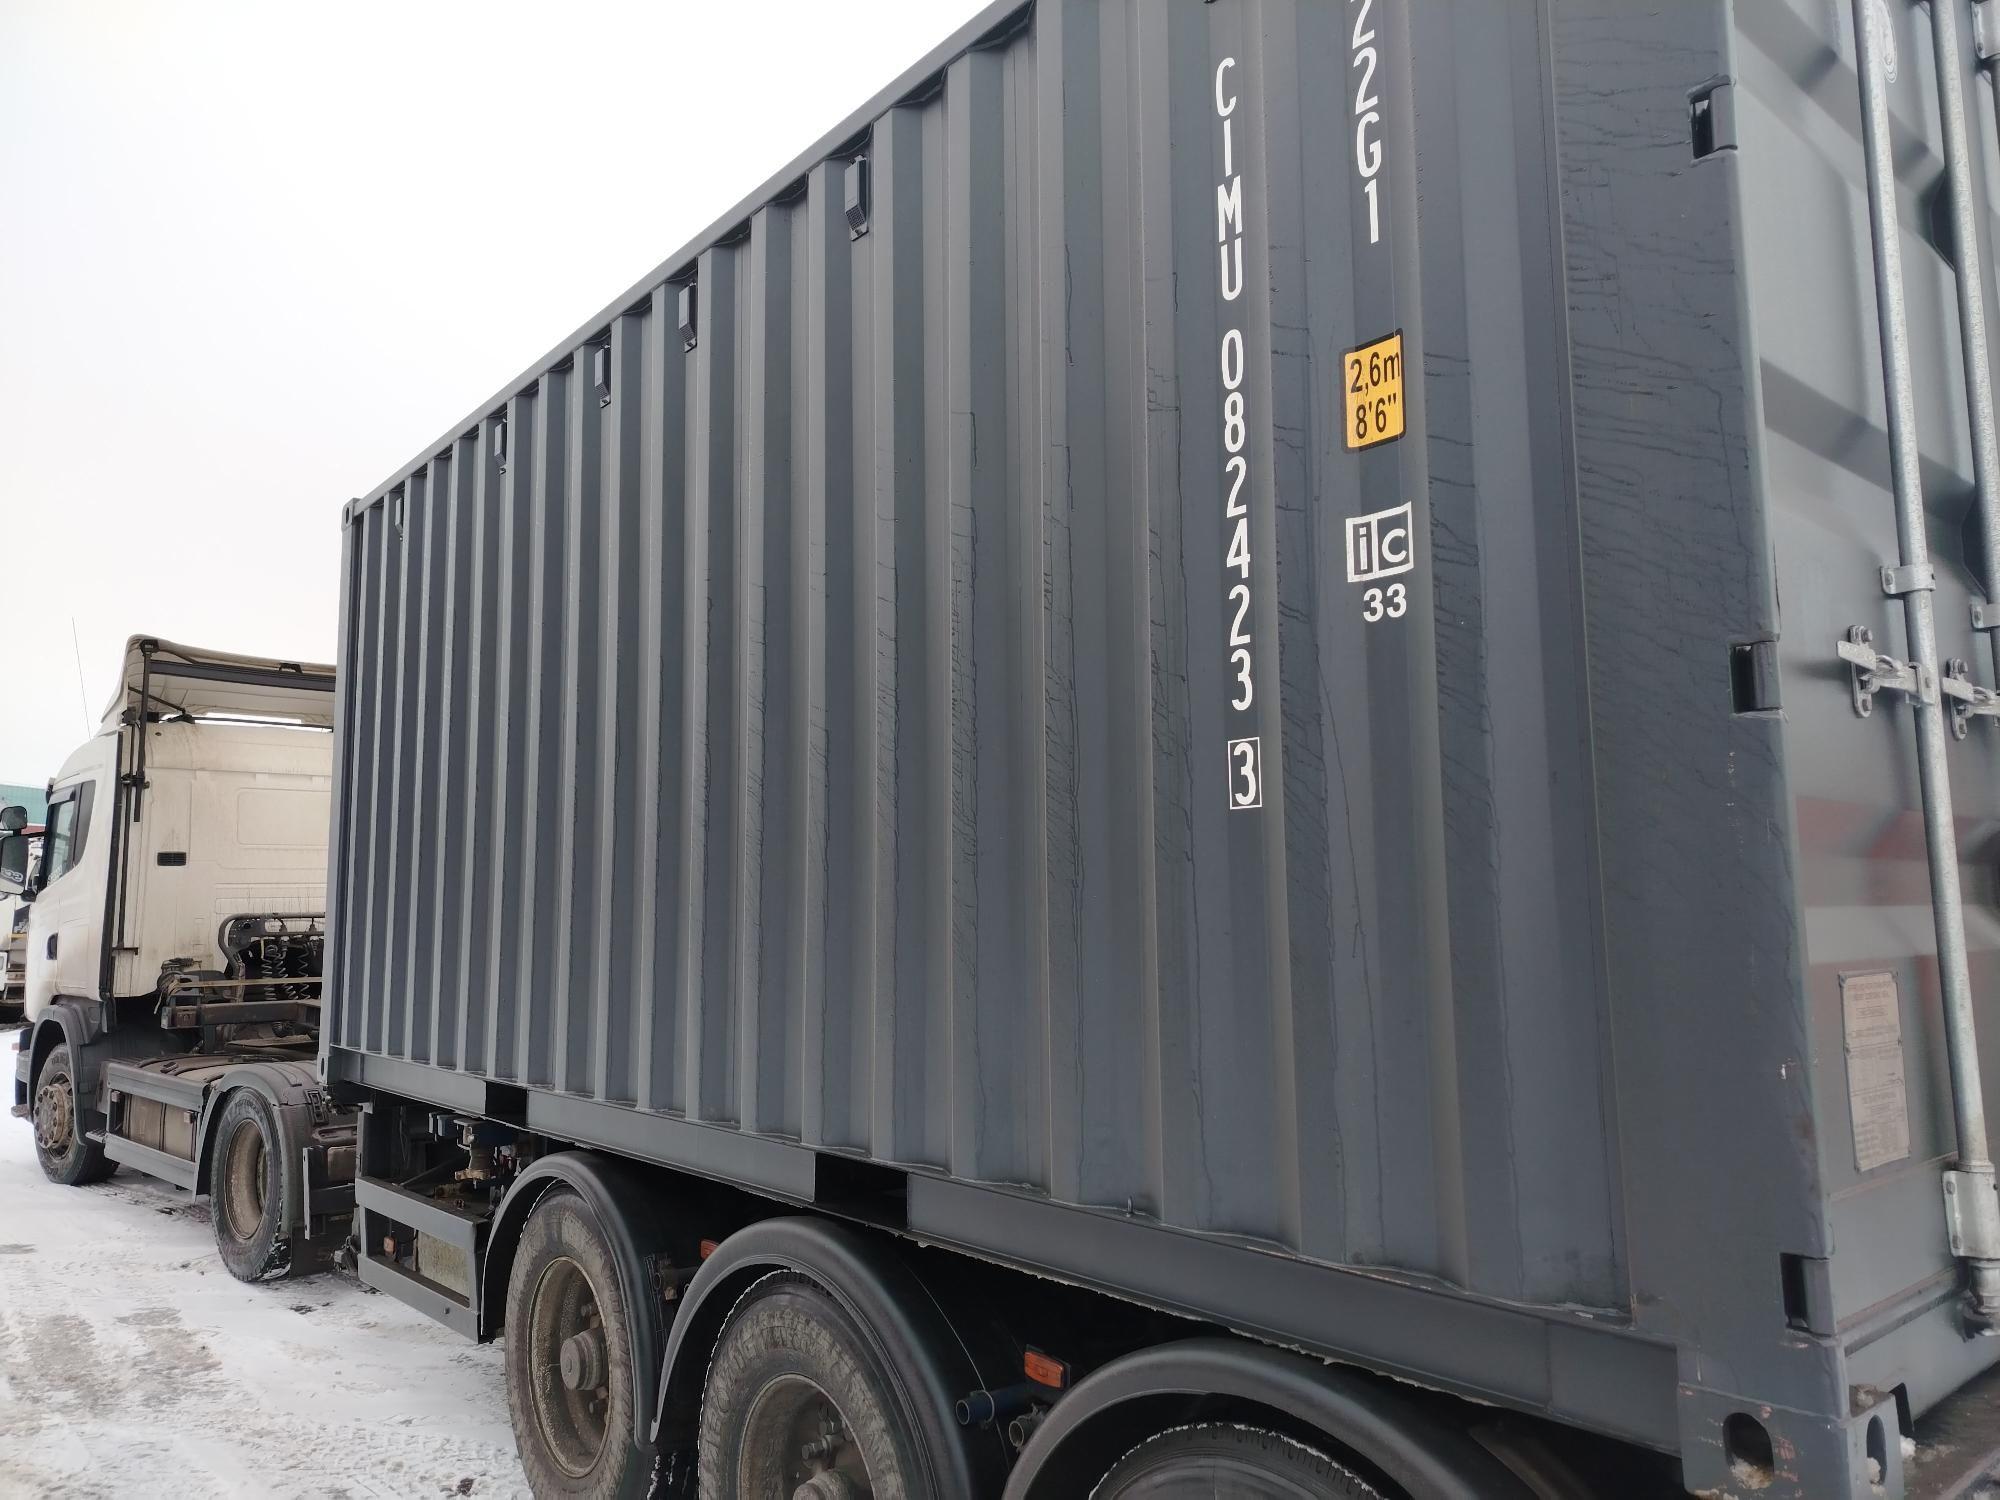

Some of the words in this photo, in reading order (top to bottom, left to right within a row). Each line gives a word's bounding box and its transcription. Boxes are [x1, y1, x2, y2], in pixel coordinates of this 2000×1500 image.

[1215, 57, 1243, 301] CIMU
[1351, 0, 1382, 244] 22G1
[1350, 352, 1400, 396] 2,6m
[1221, 329, 1253, 711] 082423
[1363, 583, 1407, 622] 33
[1233, 742, 1257, 805] 3
